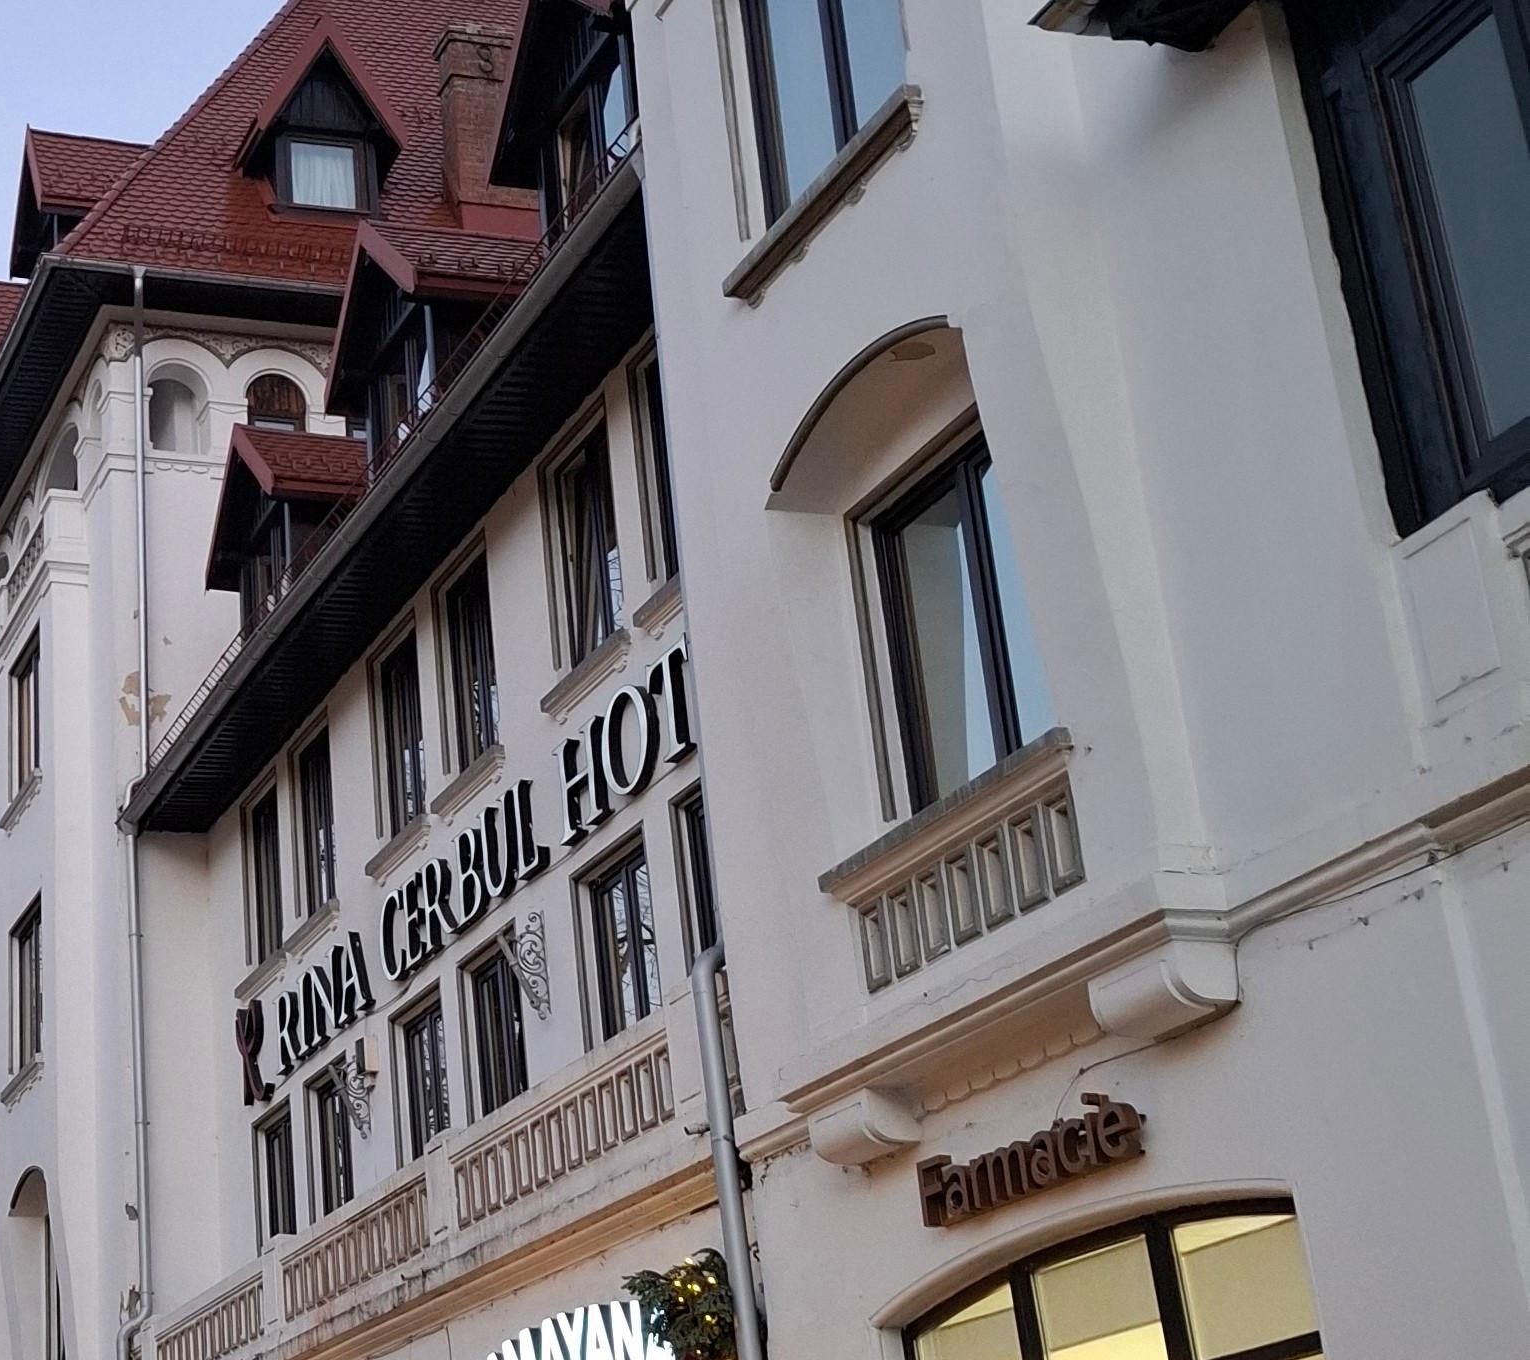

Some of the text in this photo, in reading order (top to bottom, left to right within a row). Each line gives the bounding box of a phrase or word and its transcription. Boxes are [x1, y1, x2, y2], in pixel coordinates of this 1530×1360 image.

[272, 929, 376, 1076] RINA
[380, 778, 550, 982] CERBUL
[557, 631, 698, 847] HOT
[917, 1093, 1146, 1227] Farmacie
